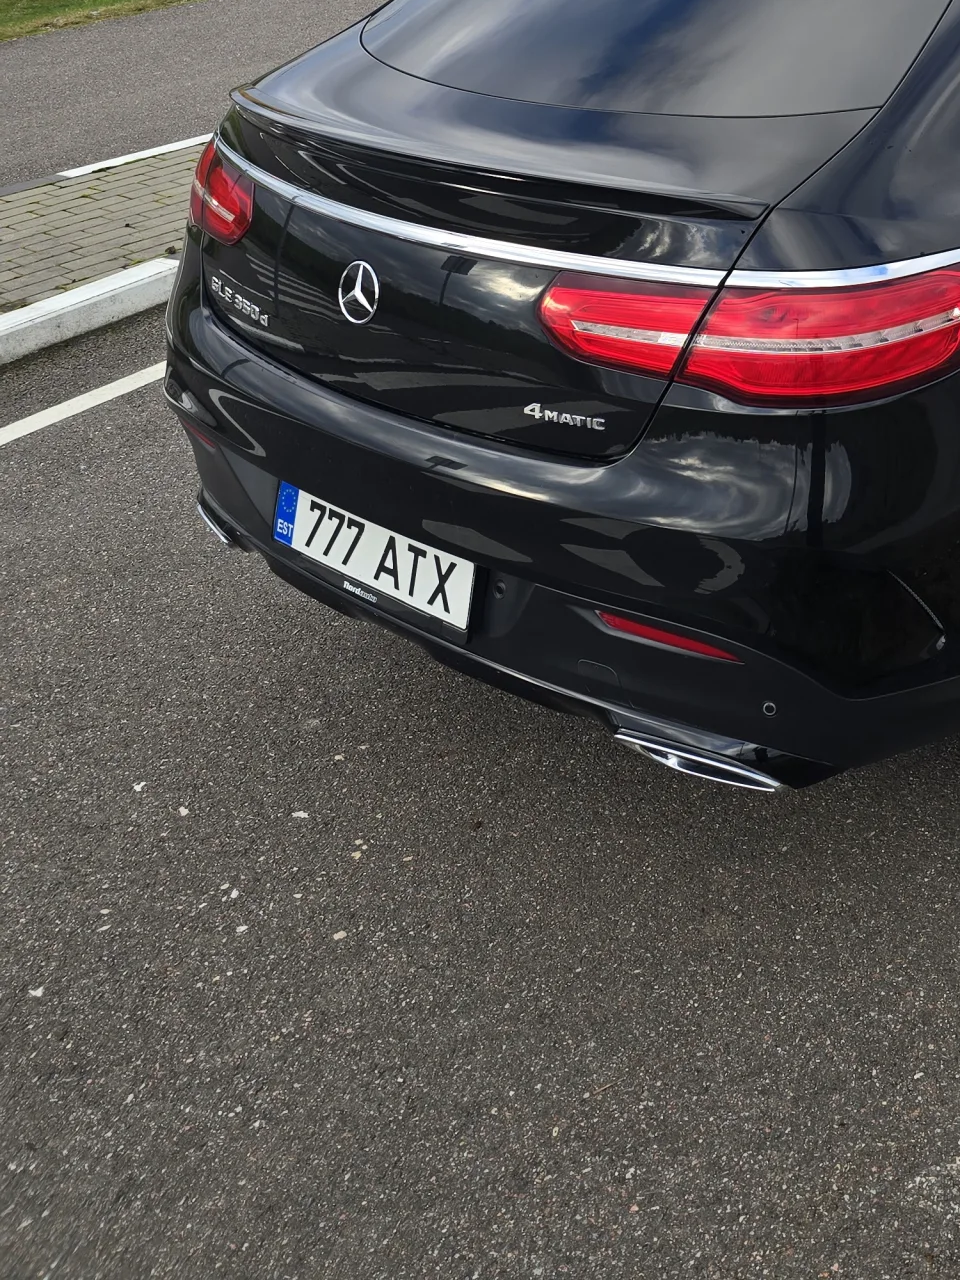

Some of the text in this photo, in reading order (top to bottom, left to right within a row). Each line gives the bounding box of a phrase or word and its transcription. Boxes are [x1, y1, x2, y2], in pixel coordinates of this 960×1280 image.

[523, 402, 605, 431] 4MATIC
[277, 519, 294, 537] EST
[305, 499, 458, 615] 777 ATX
